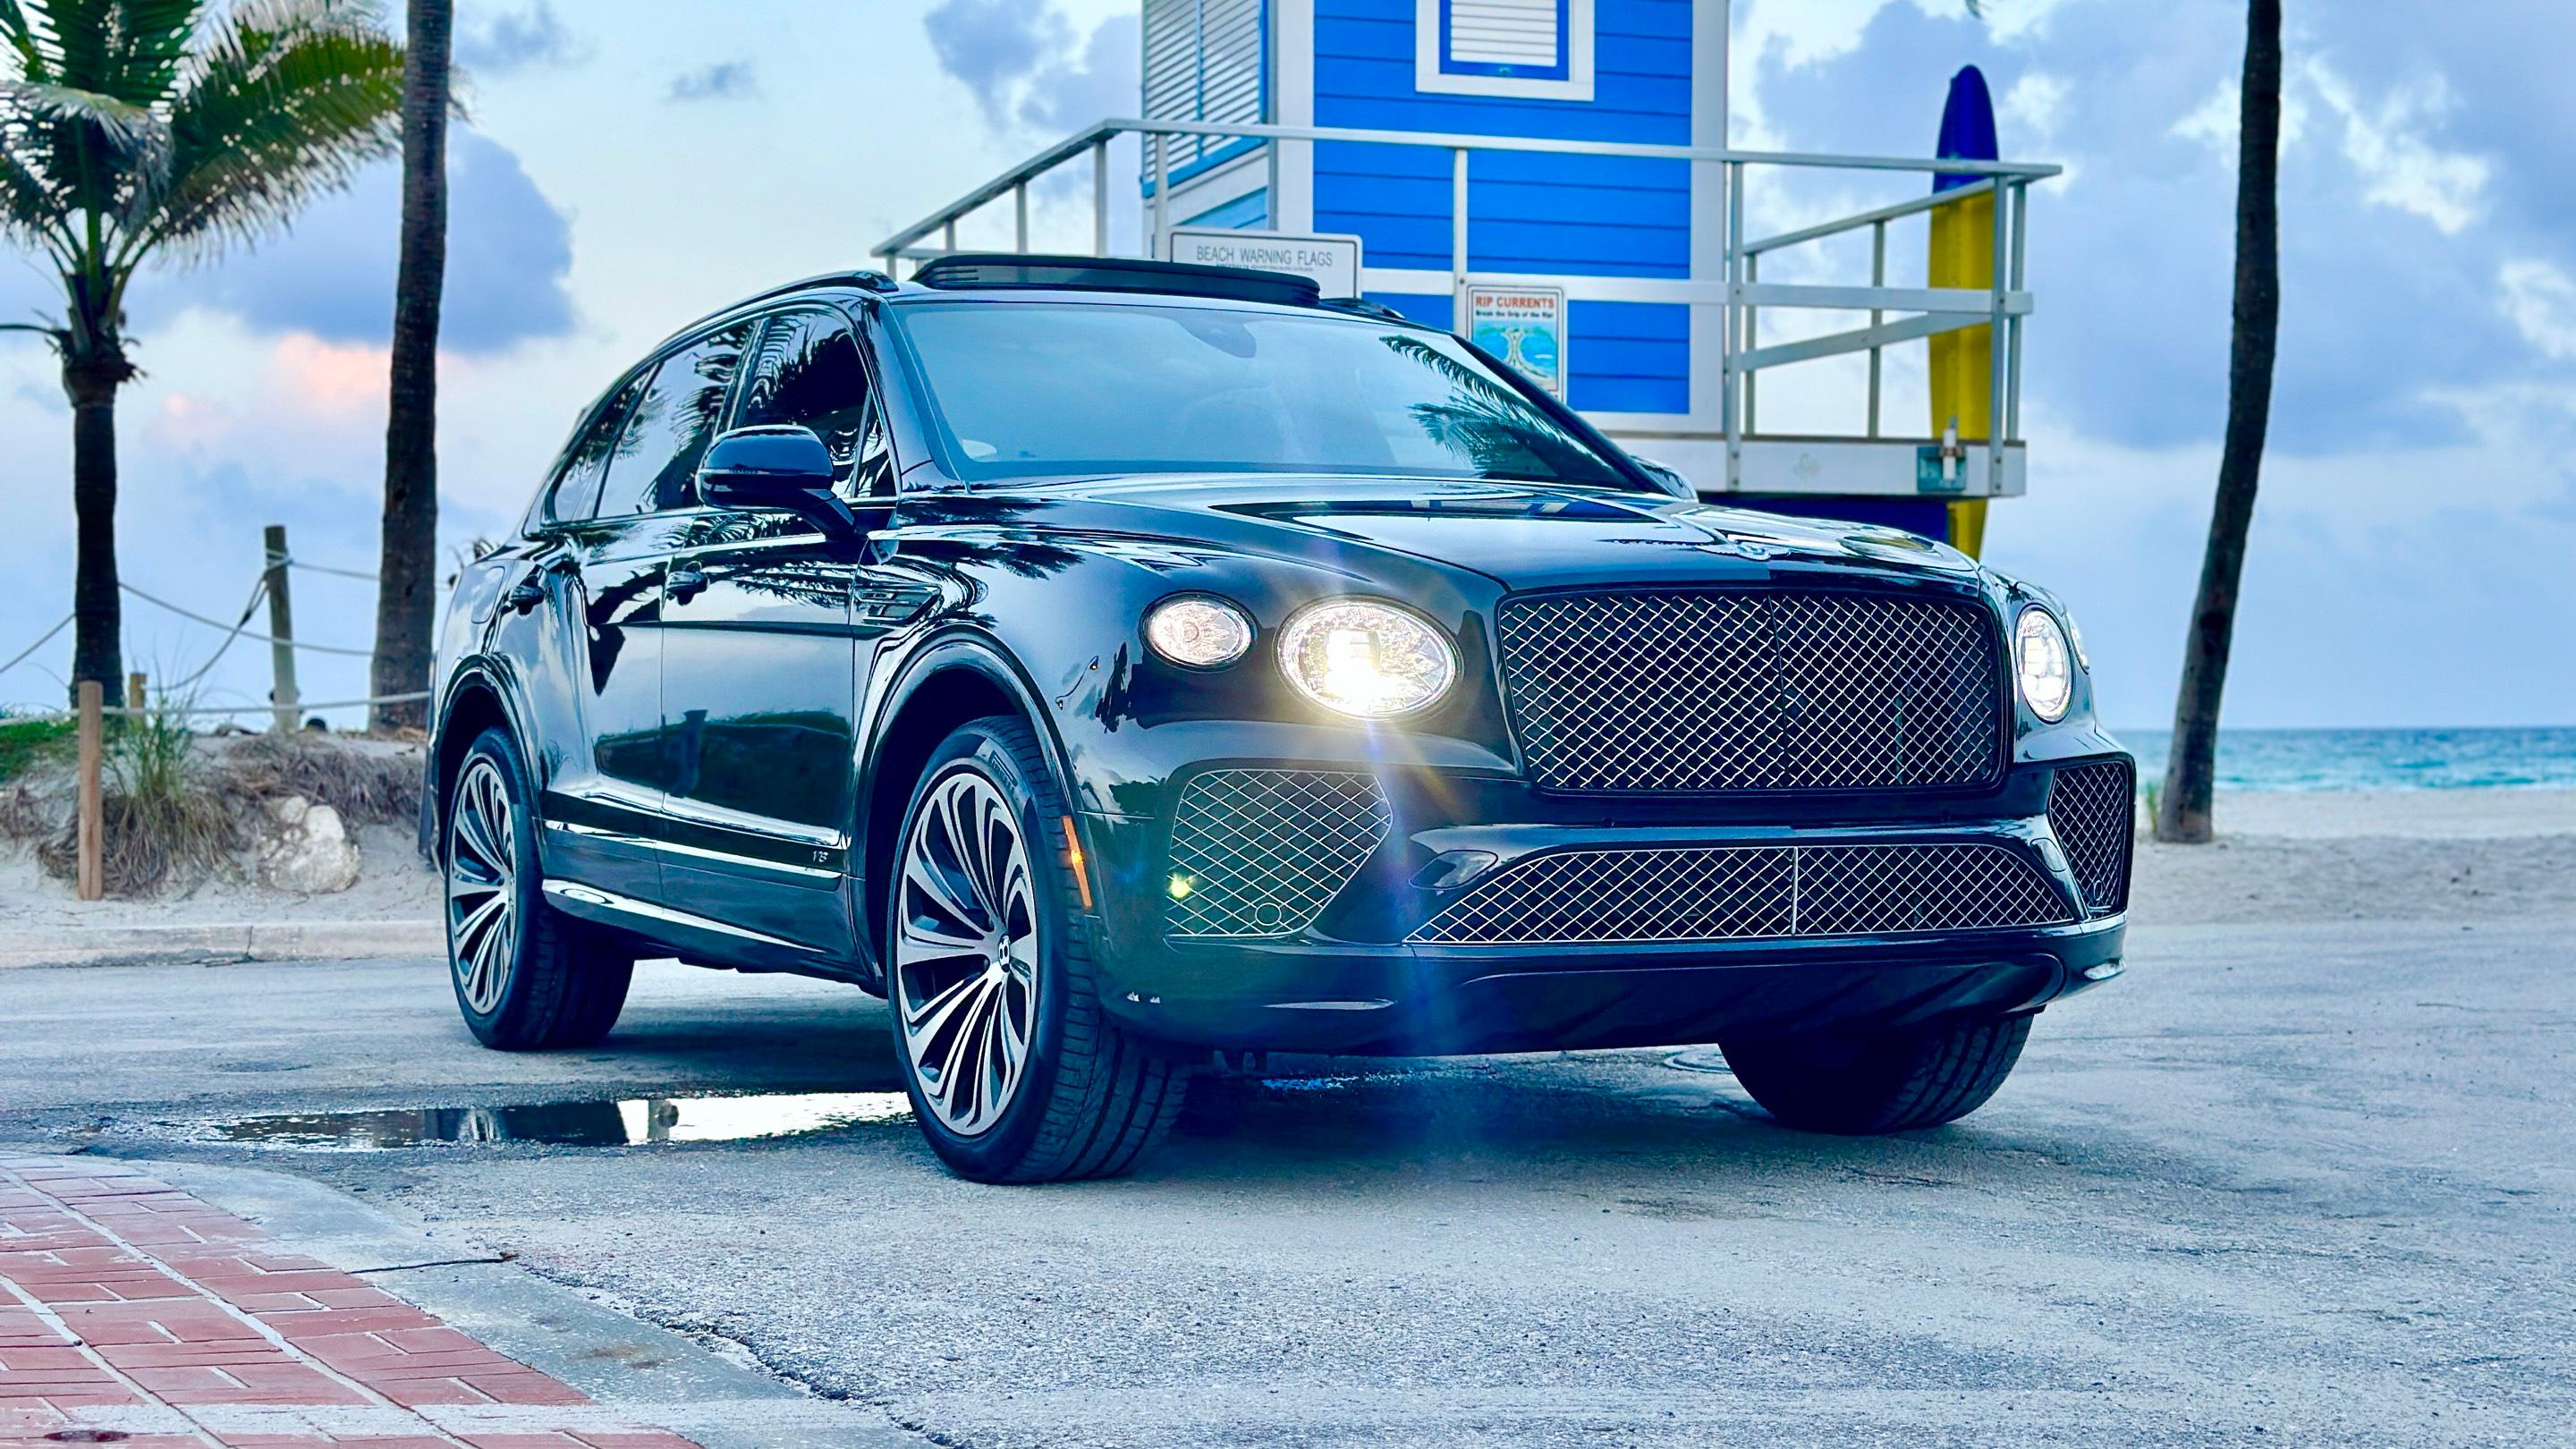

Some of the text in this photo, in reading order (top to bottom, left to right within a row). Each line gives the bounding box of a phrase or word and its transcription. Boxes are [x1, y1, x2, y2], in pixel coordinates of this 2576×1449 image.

[1196, 245, 1333, 267] BEACH WARNING FLAGS
[1476, 296, 1555, 309] RIP CURRENTS
